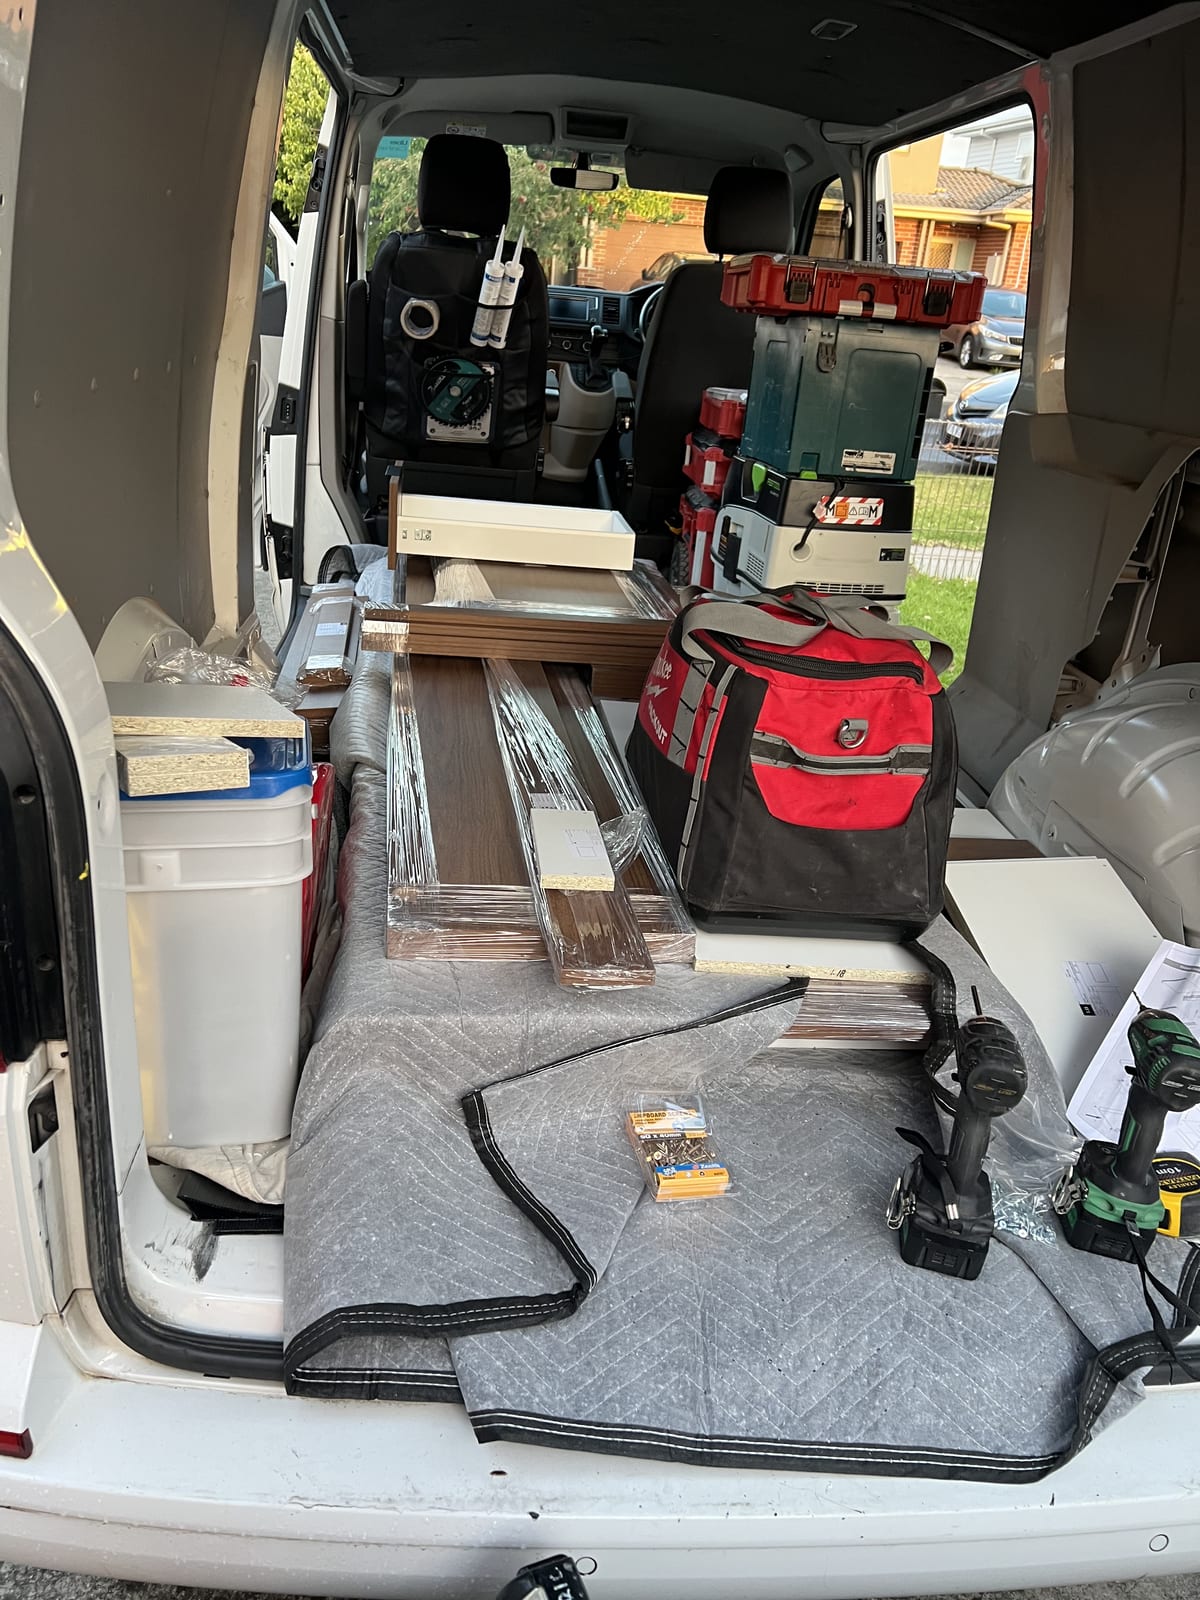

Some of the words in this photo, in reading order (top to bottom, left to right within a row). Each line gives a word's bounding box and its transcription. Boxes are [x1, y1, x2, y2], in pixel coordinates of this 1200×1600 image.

[826, 504, 835, 516] M
[869, 505, 878, 518] M
[1155, 1166, 1182, 1175] 10m
